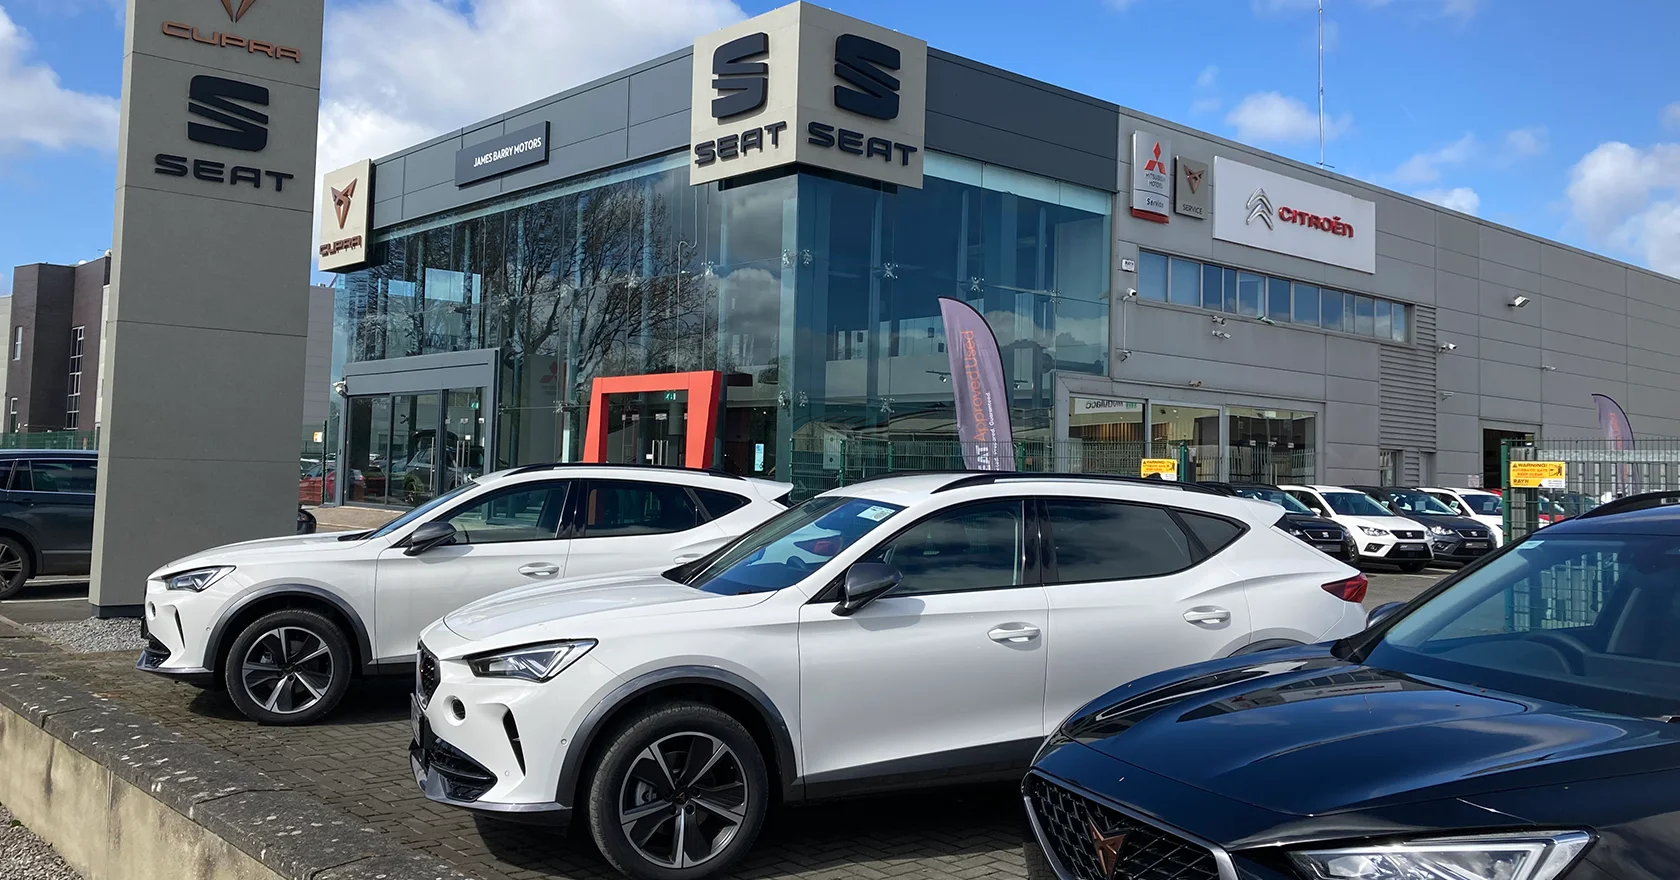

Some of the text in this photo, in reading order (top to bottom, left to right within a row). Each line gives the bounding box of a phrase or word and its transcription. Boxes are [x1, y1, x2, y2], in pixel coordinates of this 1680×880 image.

[162, 20, 302, 63] CUPRA
[473, 137, 542, 167] JAMES BARRY MOTORS
[695, 121, 787, 167] SEAT
[808, 121, 918, 166] SEAT
[155, 153, 294, 192] SEAT
[1182, 204, 1203, 215] SERVICE
[319, 235, 362, 257] CUPRA
[961, 329, 991, 471] EAT Approved Used
